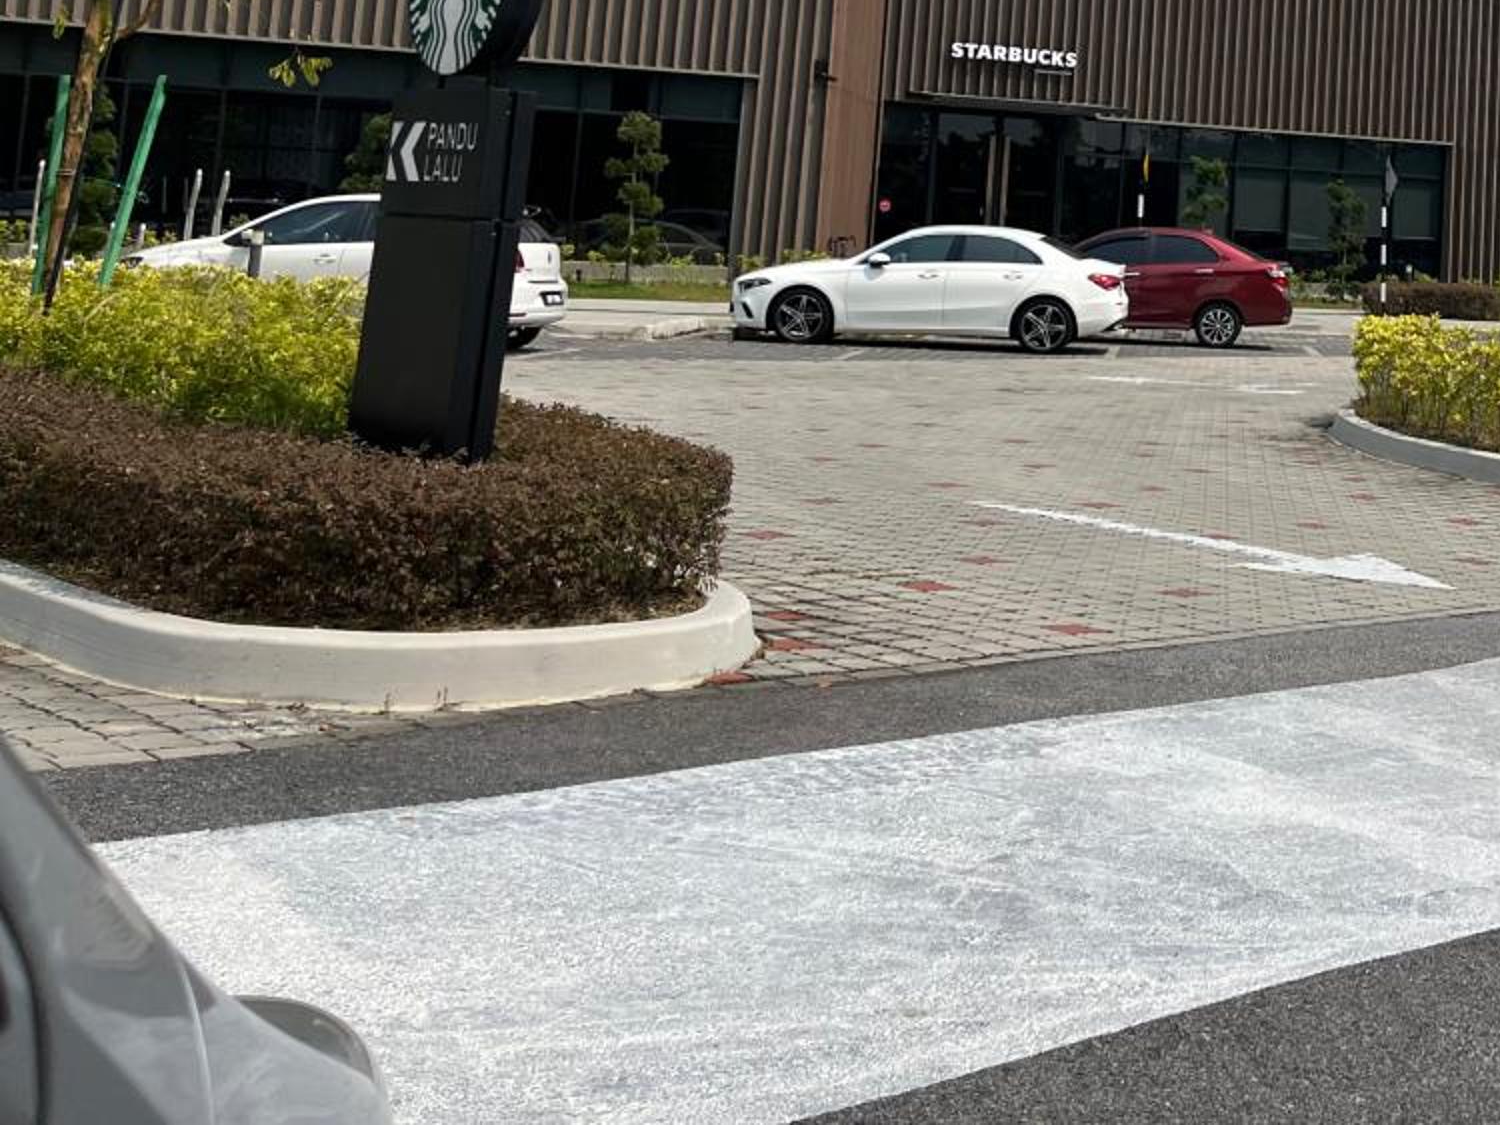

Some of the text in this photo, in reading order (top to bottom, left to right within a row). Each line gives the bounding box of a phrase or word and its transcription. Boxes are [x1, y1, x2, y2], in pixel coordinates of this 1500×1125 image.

[951, 42, 1078, 68] STARBUCKS
[427, 122, 479, 150] PANDU
[423, 154, 463, 182] LALU
